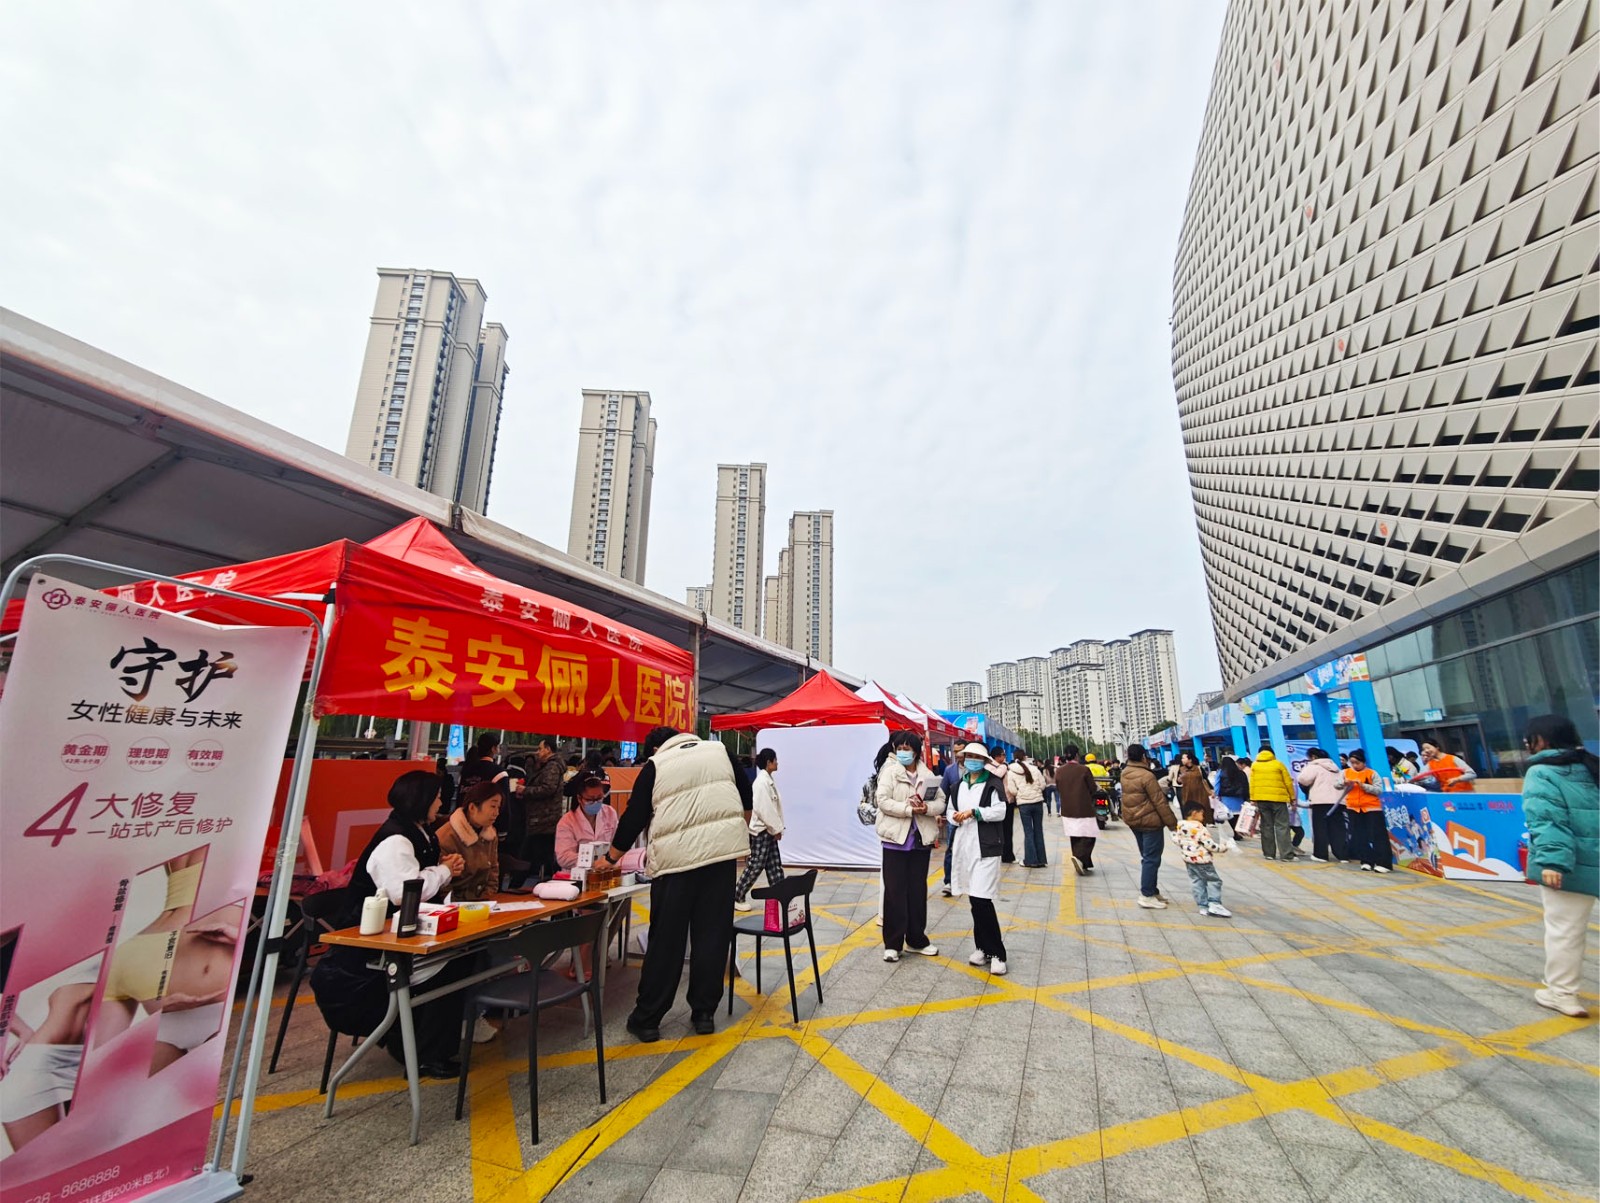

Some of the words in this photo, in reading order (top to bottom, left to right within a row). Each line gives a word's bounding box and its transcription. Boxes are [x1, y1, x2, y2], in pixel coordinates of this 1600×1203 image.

[74, 596, 162, 620] 泰安俪人医院
[479, 586, 643, 652] 泰安俪人医院
[110, 637, 238, 703] 守护
[67, 700, 242, 729] 女性健康与未来
[61, 744, 108, 757] 黄金期
[128, 747, 170, 759] 理想期
[187, 749, 224, 761] 有效期
[23, 782, 89, 848] 4
[90, 792, 198, 820] 大修复
[87, 817, 233, 839] 一站式产后修护
